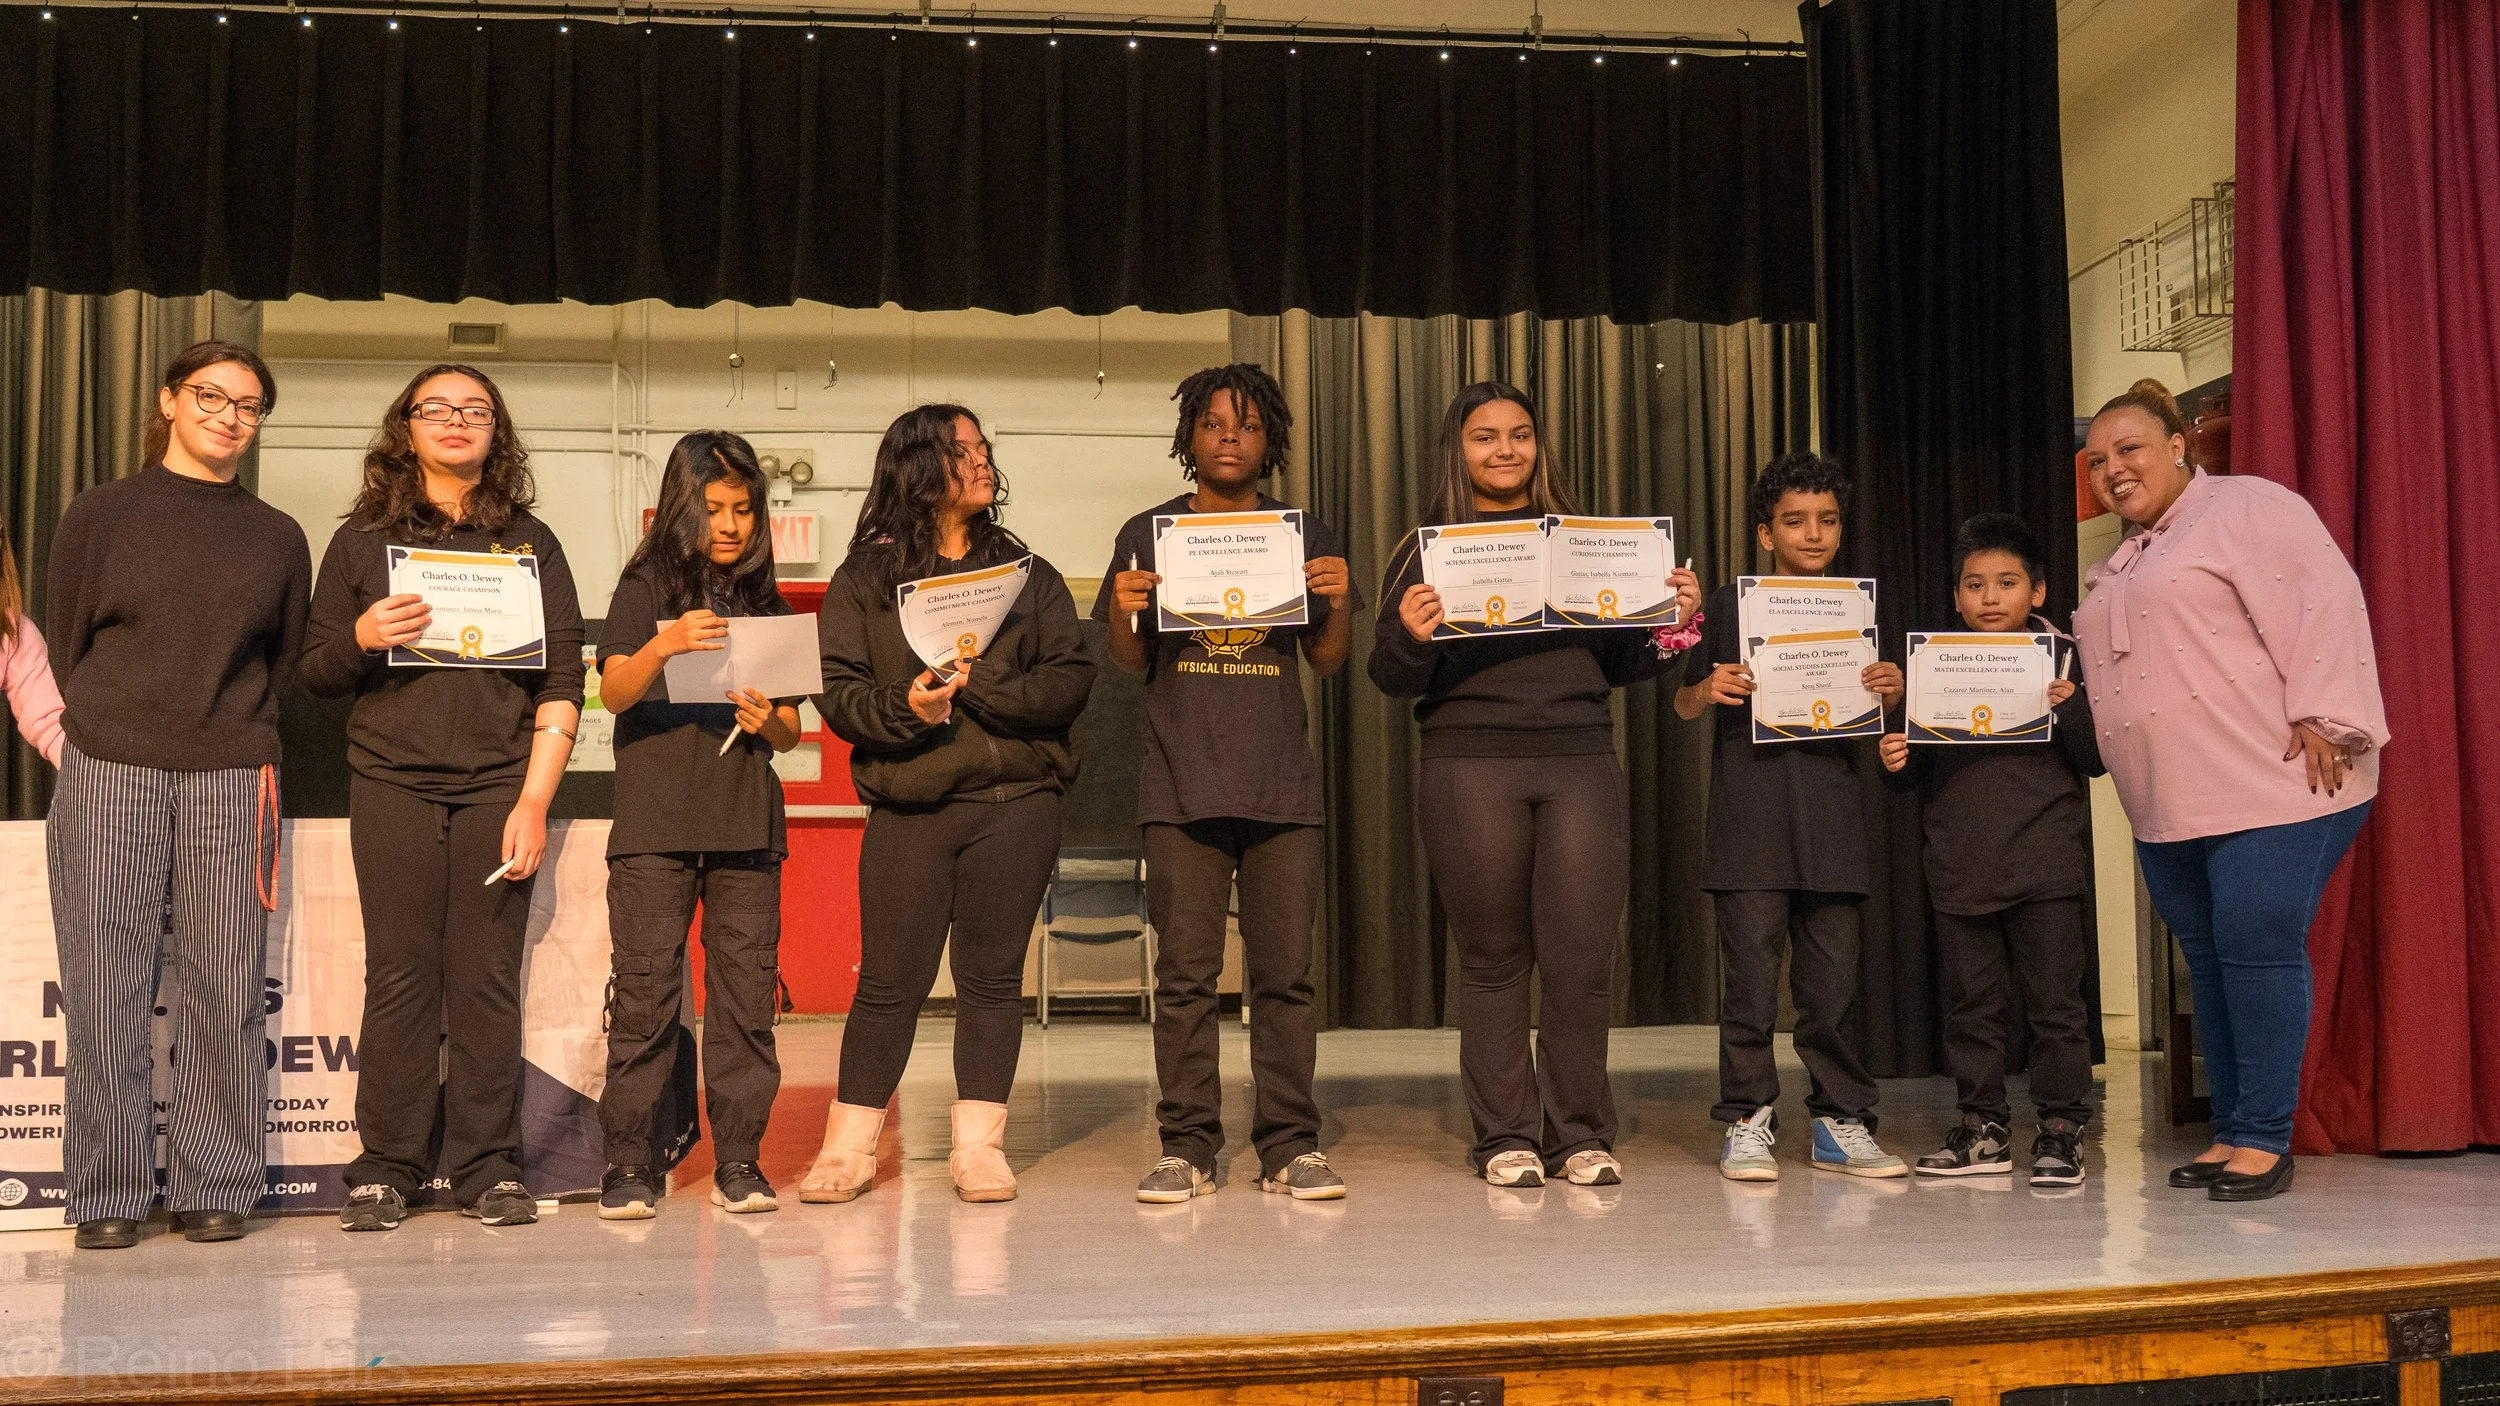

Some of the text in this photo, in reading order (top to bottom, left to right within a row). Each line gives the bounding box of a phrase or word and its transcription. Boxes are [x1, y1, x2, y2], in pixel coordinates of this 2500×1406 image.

[770, 516, 813, 560] XIT
[1187, 534, 1267, 545] Charles O. Dewey
[1569, 537, 1639, 548] Charles O. Dewey
[1198, 548, 1243, 556] EXCELLENCE
[1452, 542, 1526, 554] Charles O. Dewey
[1473, 556, 1512, 564] EXCELLENCE
[422, 571, 503, 585] Charles O. Dewey
[463, 586, 501, 594] CHAMPION
[927, 584, 1003, 604] Charles O. Dewey
[924, 593, 1006, 615] COMMITMENT CHAMPION
[1769, 596, 1844, 607] Charles O. Dewey
[1778, 649, 1850, 661] Charles O. Dewey
[1939, 653, 2018, 664] Charles O. Dewey
[1177, 661, 1280, 677] HYSICAL EDUCATION
[1795, 663, 1820, 671] STUDIES
[1821, 660, 1859, 669] EXCELLENCE
